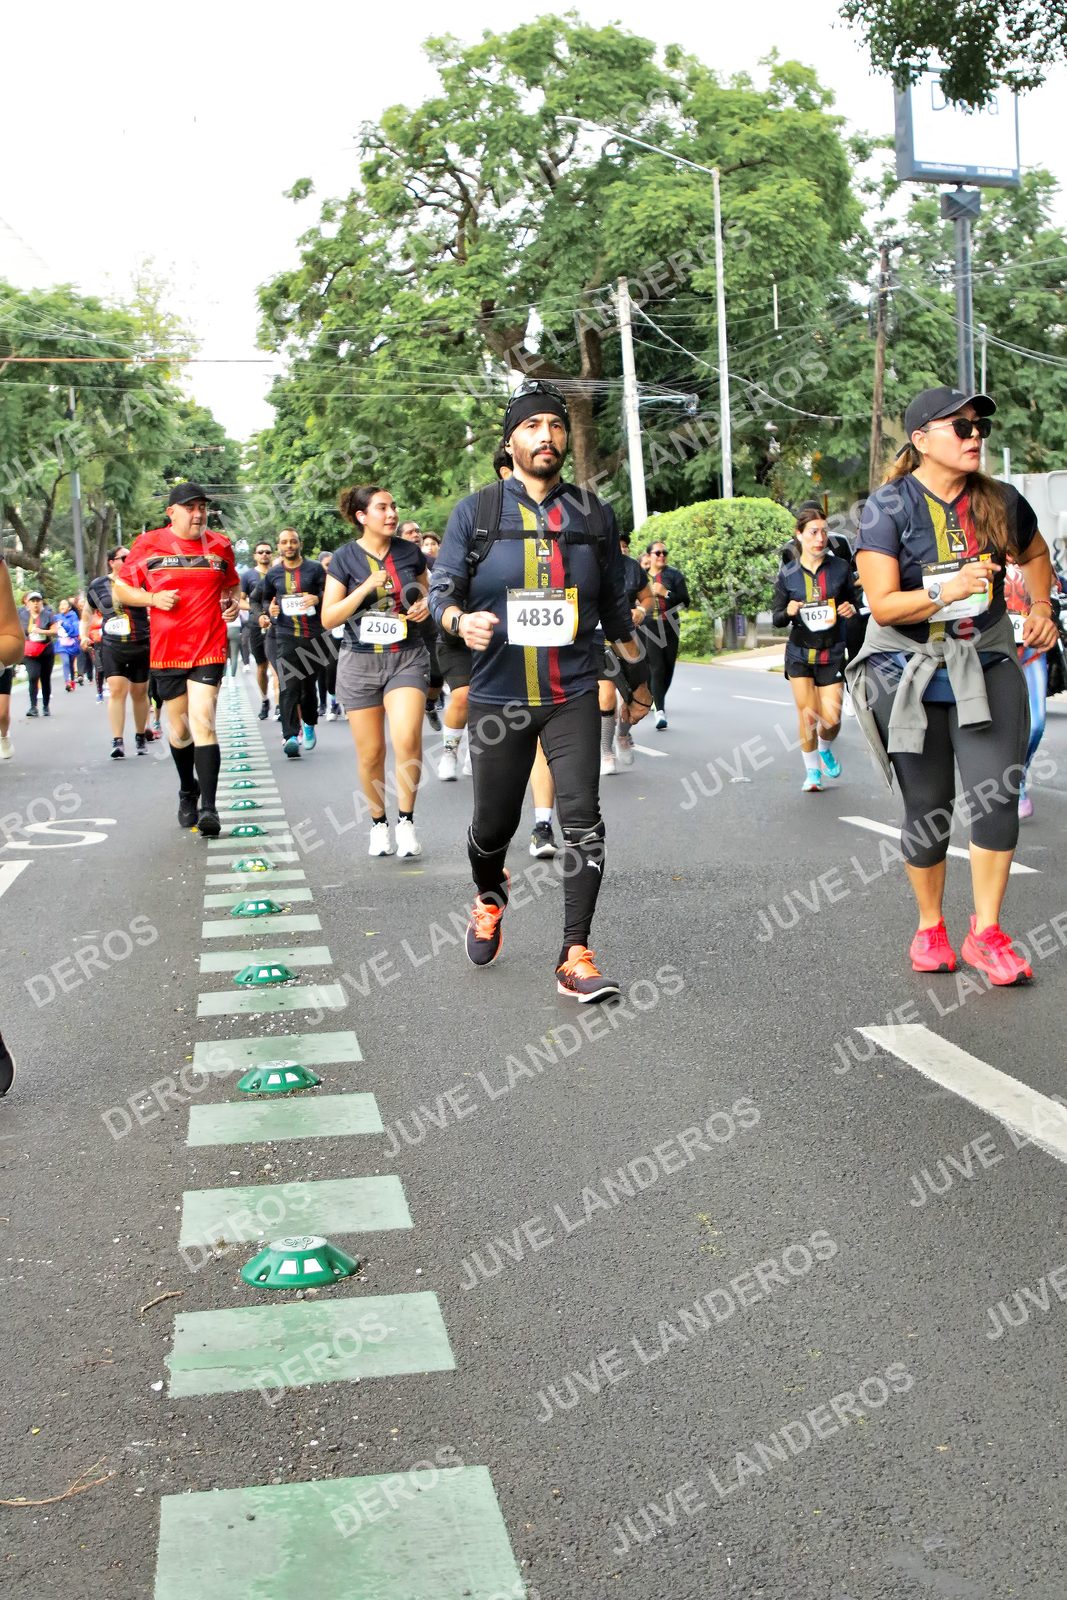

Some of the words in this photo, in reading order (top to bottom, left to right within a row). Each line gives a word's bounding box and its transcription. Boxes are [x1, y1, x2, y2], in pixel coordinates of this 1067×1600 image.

[516, 607, 565, 628] 4836
[804, 609, 829, 622] 1657
[366, 620, 398, 635] 2506
